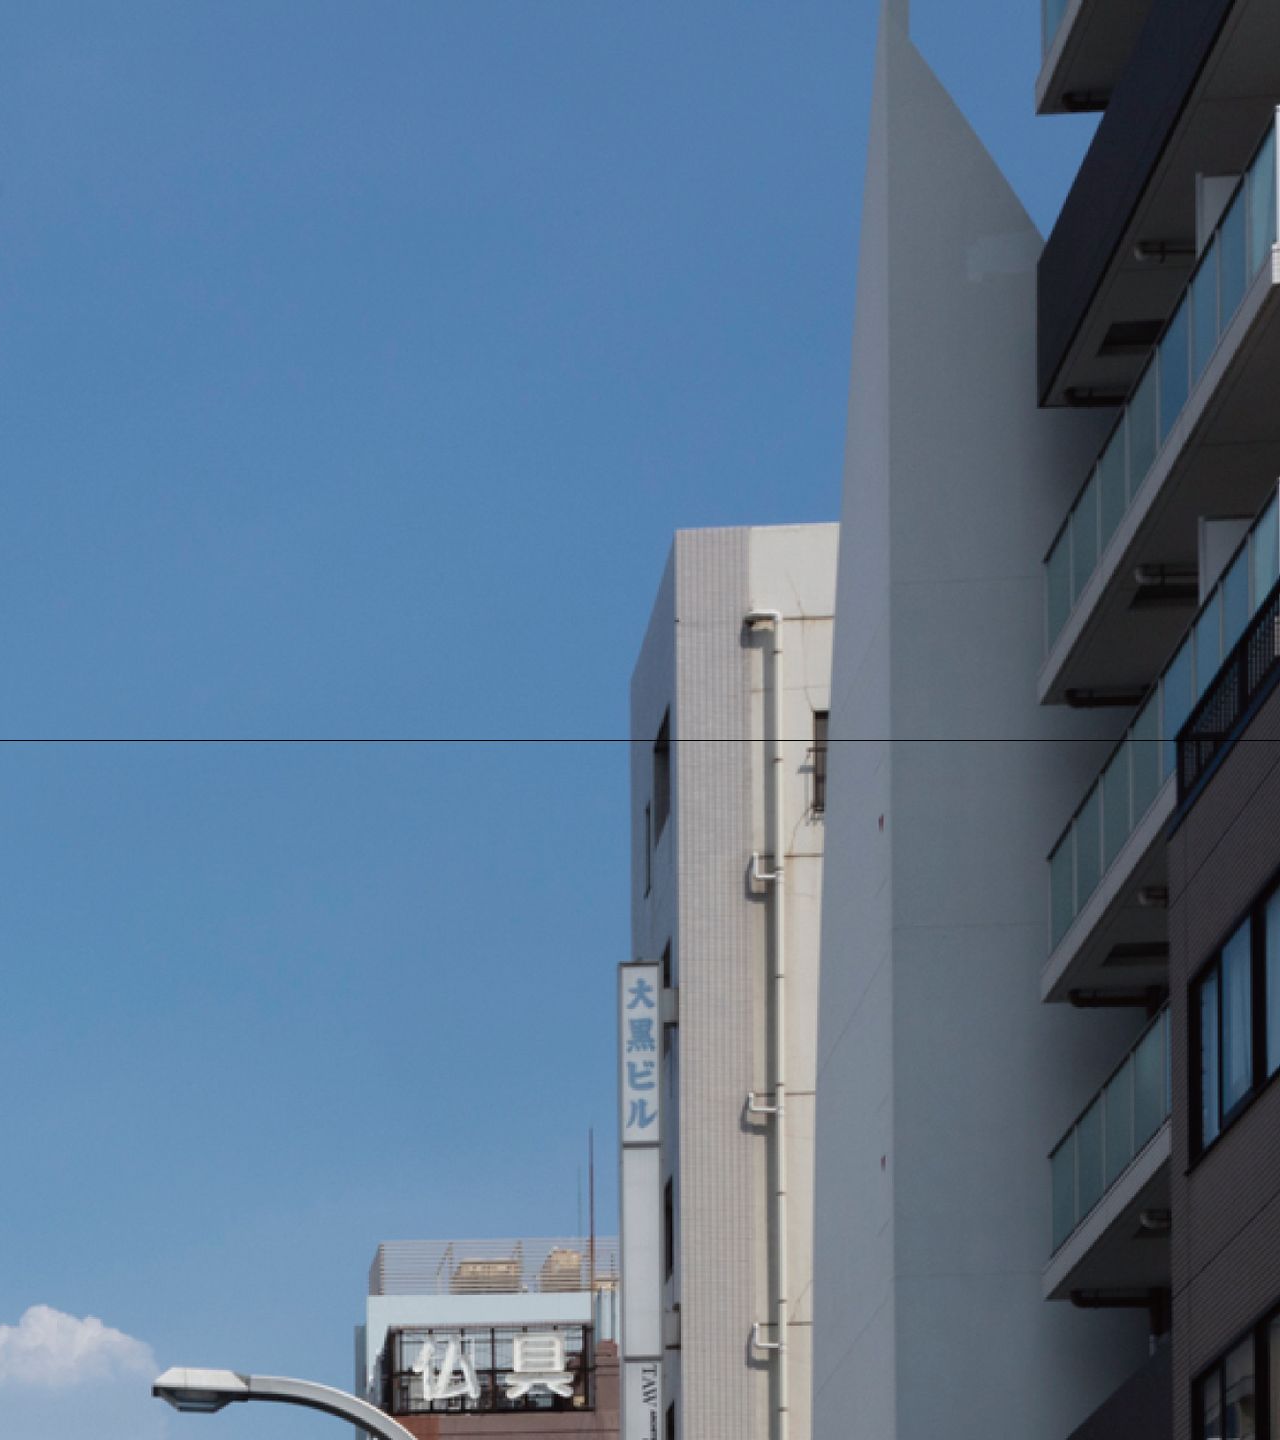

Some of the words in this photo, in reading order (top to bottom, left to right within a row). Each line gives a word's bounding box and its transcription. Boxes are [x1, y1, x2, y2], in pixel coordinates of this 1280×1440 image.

[626, 977, 658, 1130] 大黒ビル
[411, 1330, 575, 1402] 仏具
